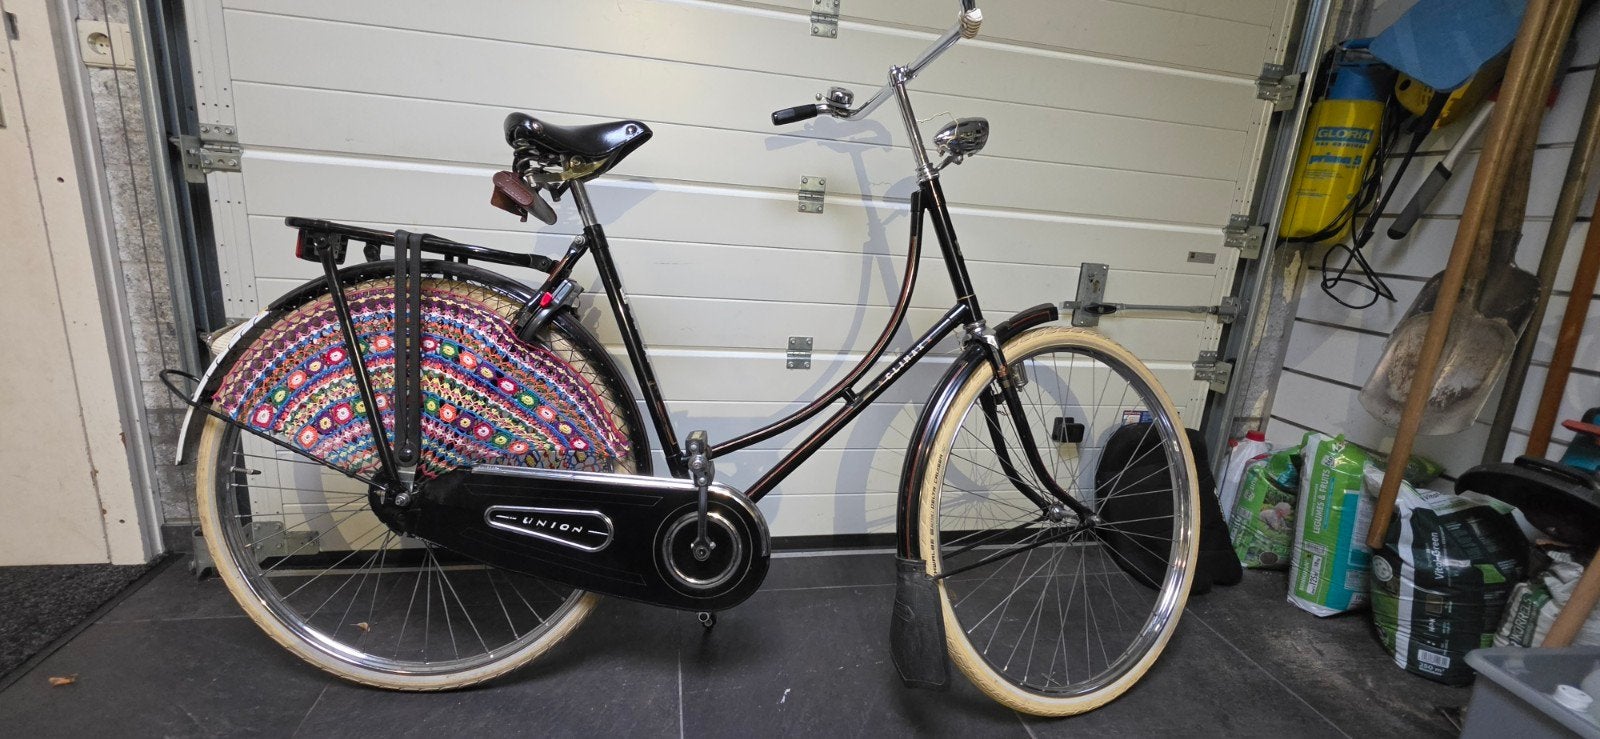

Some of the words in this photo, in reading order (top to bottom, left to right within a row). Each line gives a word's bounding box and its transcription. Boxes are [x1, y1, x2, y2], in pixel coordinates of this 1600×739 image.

[1318, 129, 1370, 141] GLORIA
[1319, 469, 1331, 493] FRUITS
[522, 516, 584, 533] UNION
[1313, 501, 1326, 534] LEGUMES
